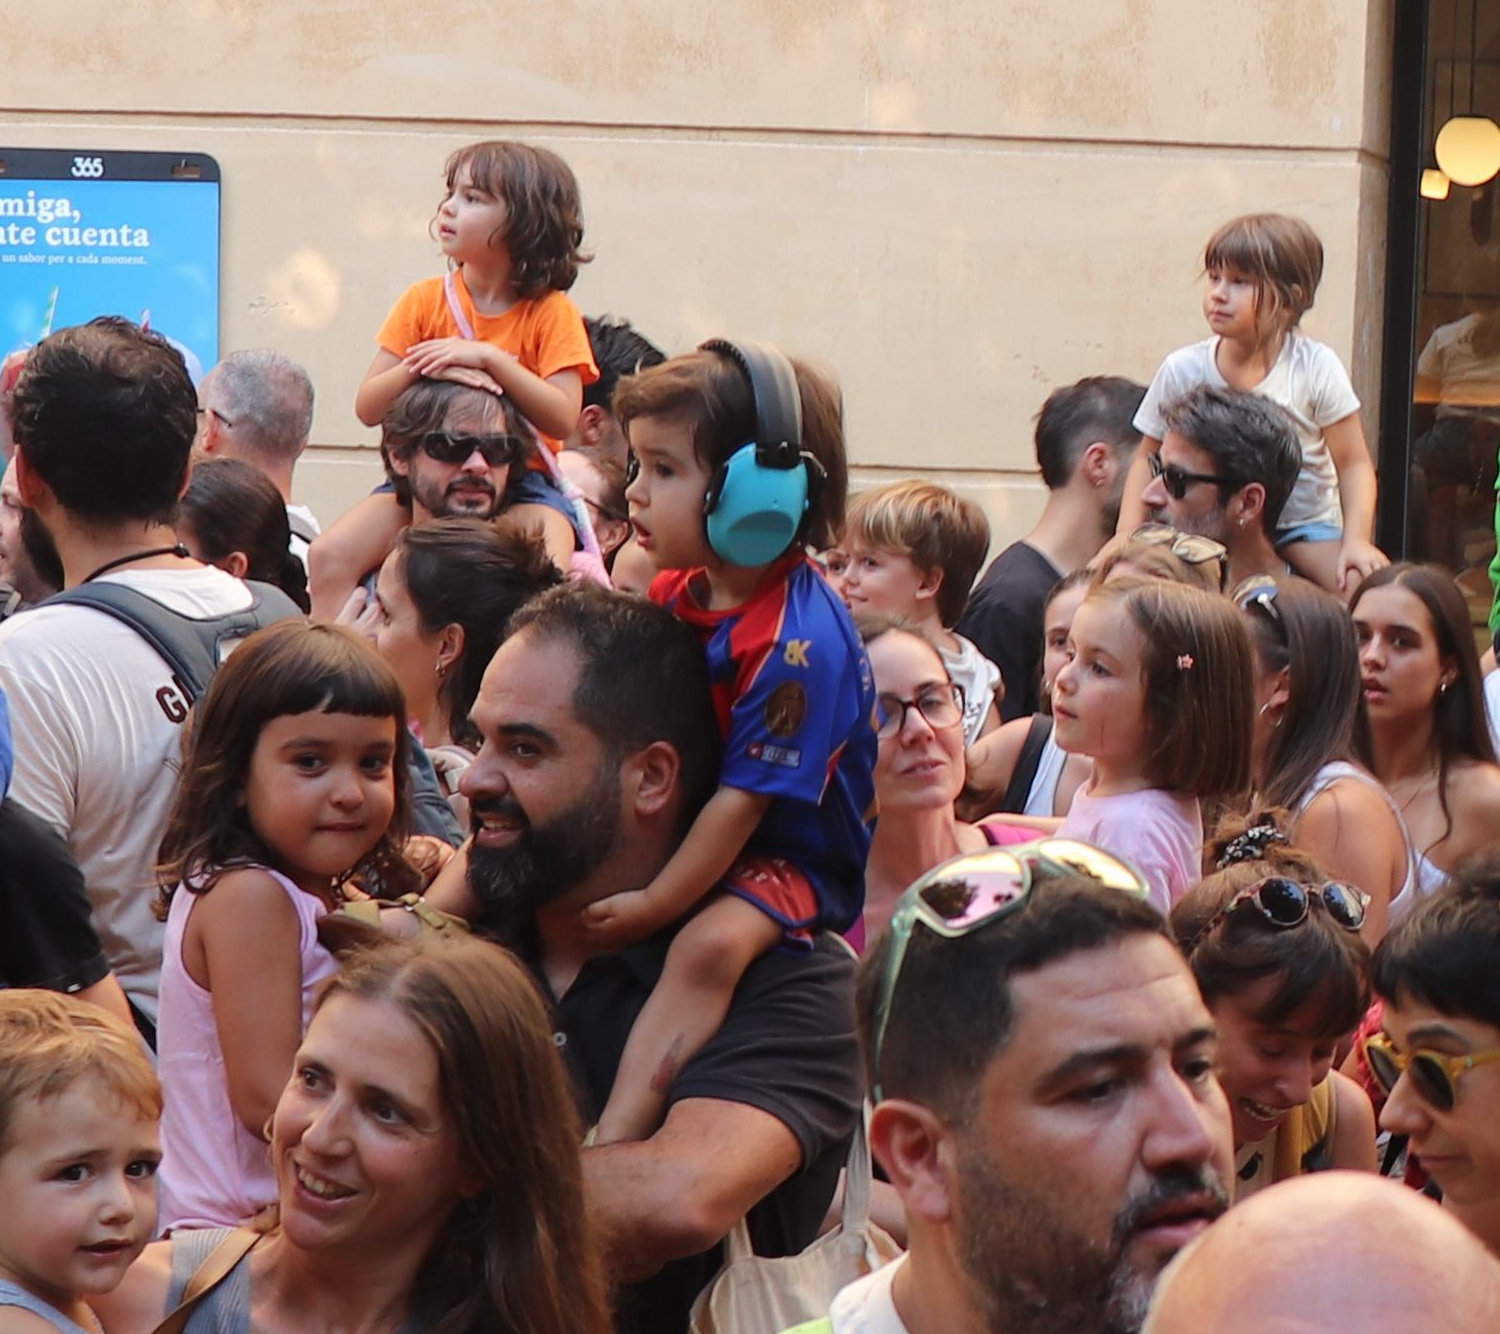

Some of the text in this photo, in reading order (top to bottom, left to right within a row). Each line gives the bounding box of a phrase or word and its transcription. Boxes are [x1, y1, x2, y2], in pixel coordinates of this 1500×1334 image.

[70, 156, 104, 178] 365
[45, 223, 150, 248] cuenta
[2, 255, 17, 264] un
[18, 252, 46, 264] sabor
[47, 256, 65, 267] per
[75, 254, 100, 265] cada
[101, 254, 149, 266] moment.
